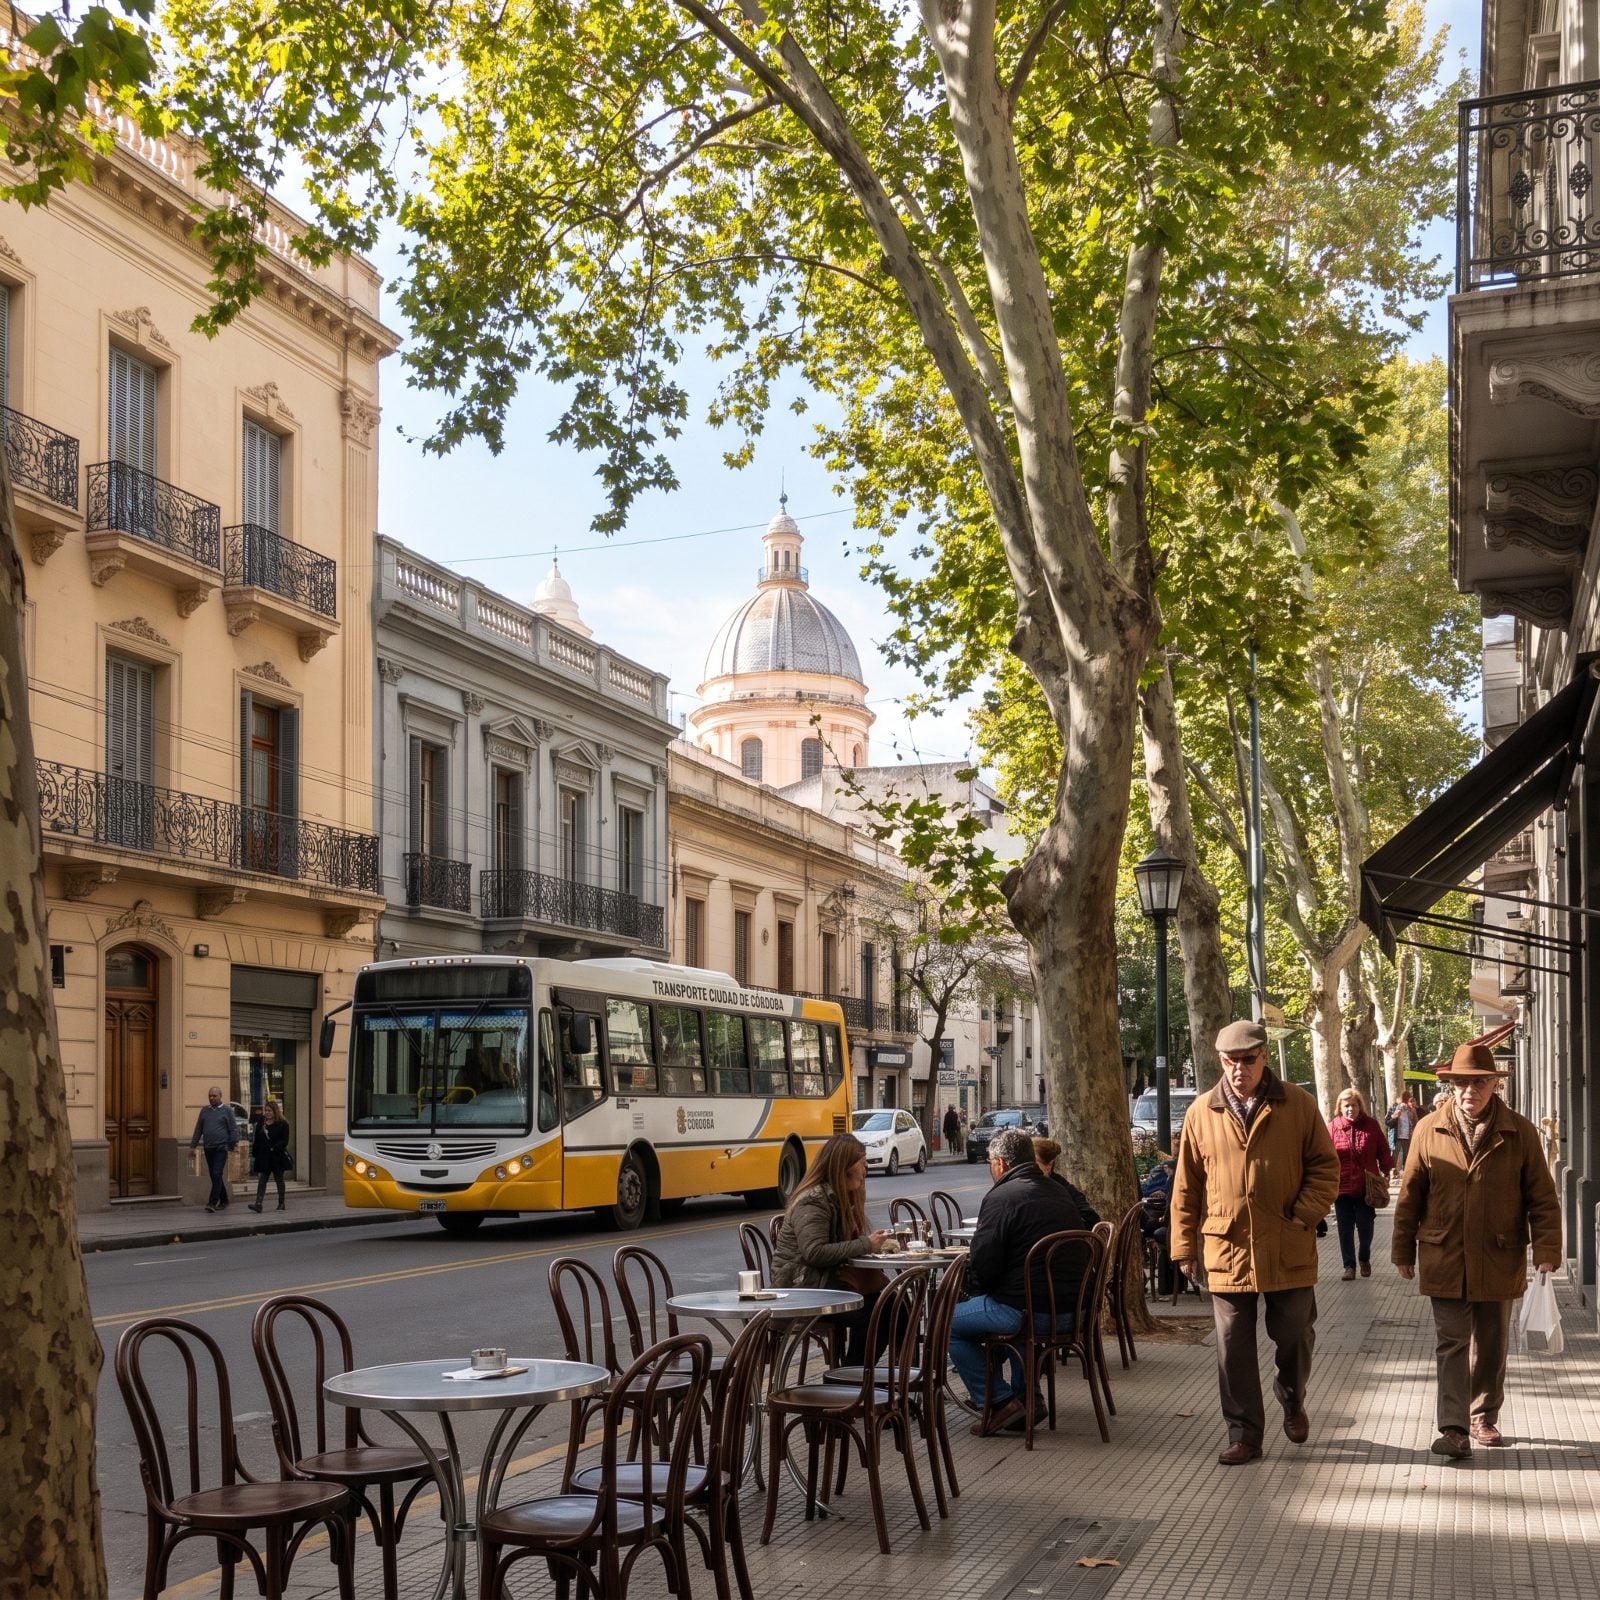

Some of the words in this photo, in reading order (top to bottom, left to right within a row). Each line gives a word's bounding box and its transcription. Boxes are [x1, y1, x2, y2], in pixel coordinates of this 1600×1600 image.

[652, 980, 707, 1001] TRANSPORTE
[709, 988, 738, 1006] CIUDAD
[739, 993, 750, 1007] DE
[750, 993, 784, 1011] CÓRDOBA
